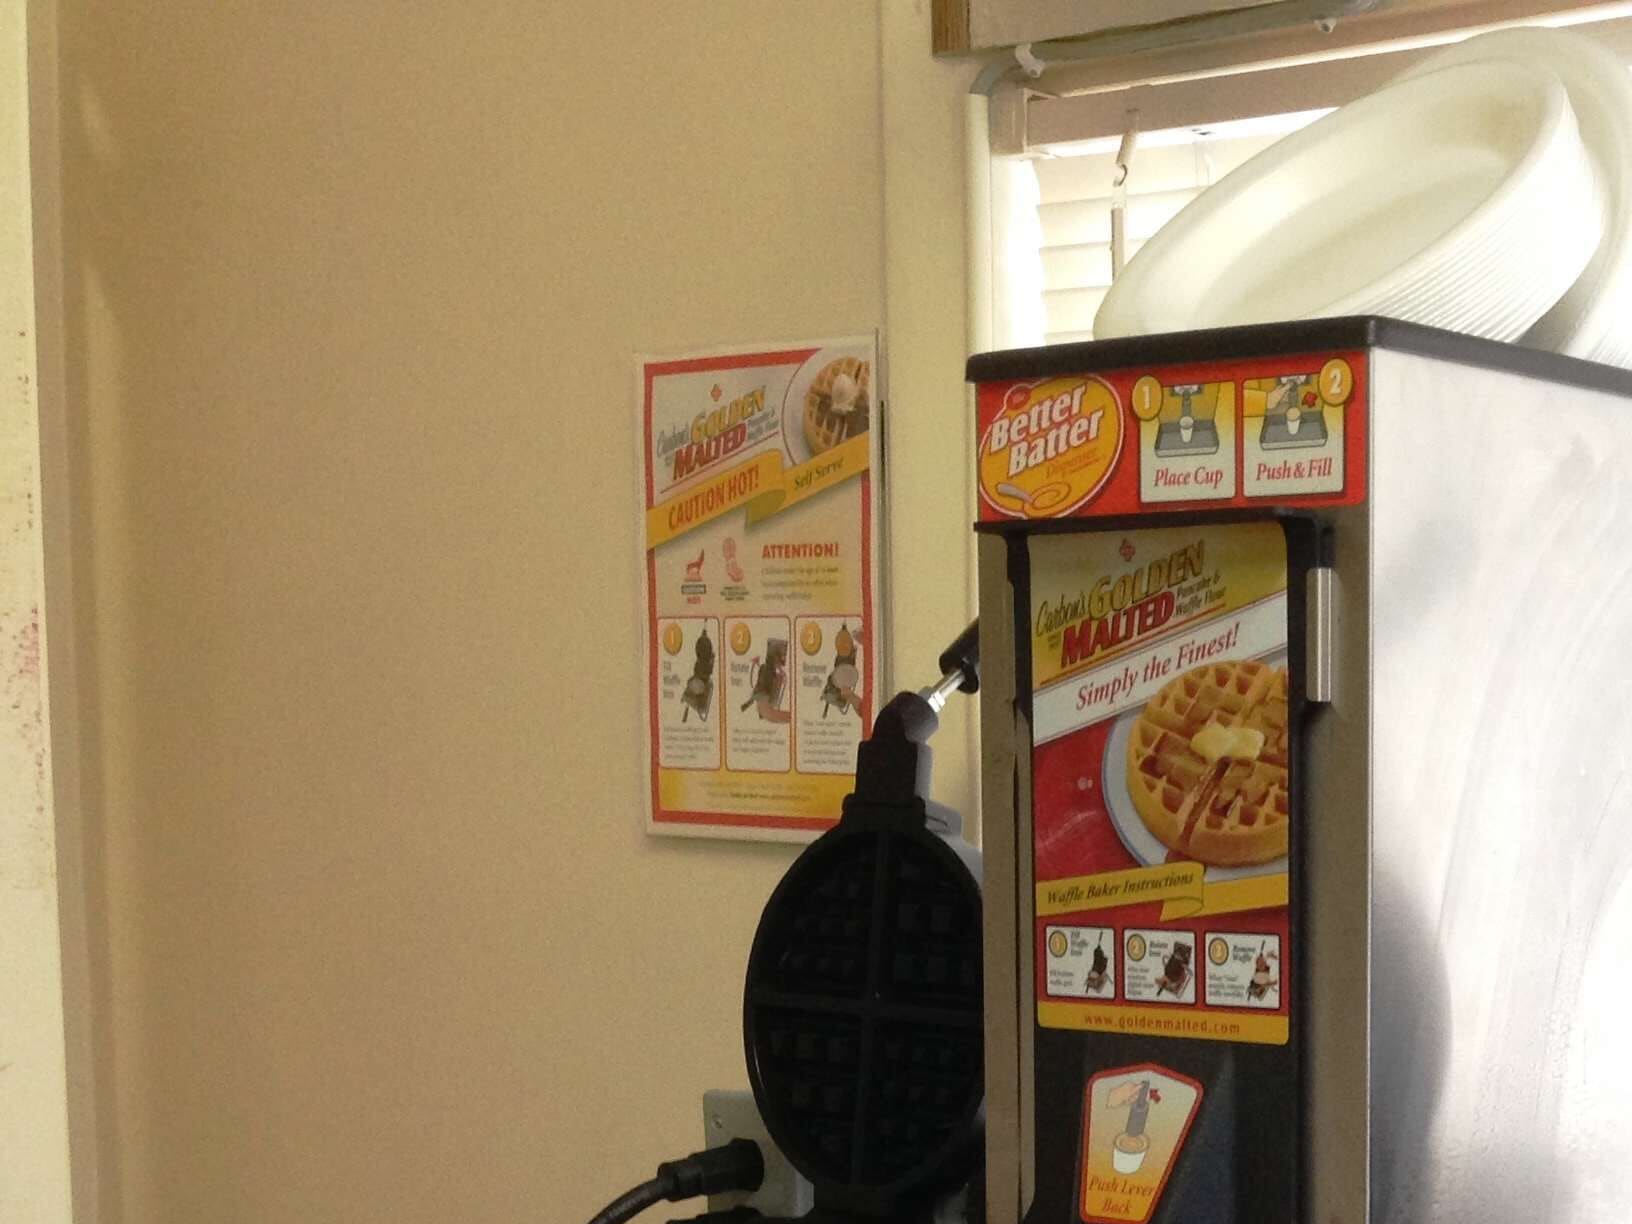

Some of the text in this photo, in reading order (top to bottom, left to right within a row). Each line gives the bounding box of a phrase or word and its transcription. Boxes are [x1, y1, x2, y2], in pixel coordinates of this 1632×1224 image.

[1329, 368, 1342, 395] 2
[1142, 388, 1151, 410] 1
[990, 385, 1086, 453] Better
[674, 422, 747, 480] MALTED
[1008, 410, 1104, 477] Batter
[794, 457, 844, 490] Self Serve
[1154, 466, 1223, 488] Place Cup
[1256, 458, 1333, 481] Push & Fill
[668, 464, 760, 531] CAUTION HOT!
[762, 543, 839, 559] ATTENTION!
[1089, 539, 1205, 620] GOLDEN
[1061, 591, 1176, 669] MALTED
[1076, 622, 1240, 711] Simply the Finest!
[1048, 872, 1194, 906] Waffle Baker Instructions
[1084, 1013, 1240, 1035] www.goldenmalted.com
[1089, 1175, 1154, 1196] Push Lever
[1102, 1199, 1131, 1215] Back
